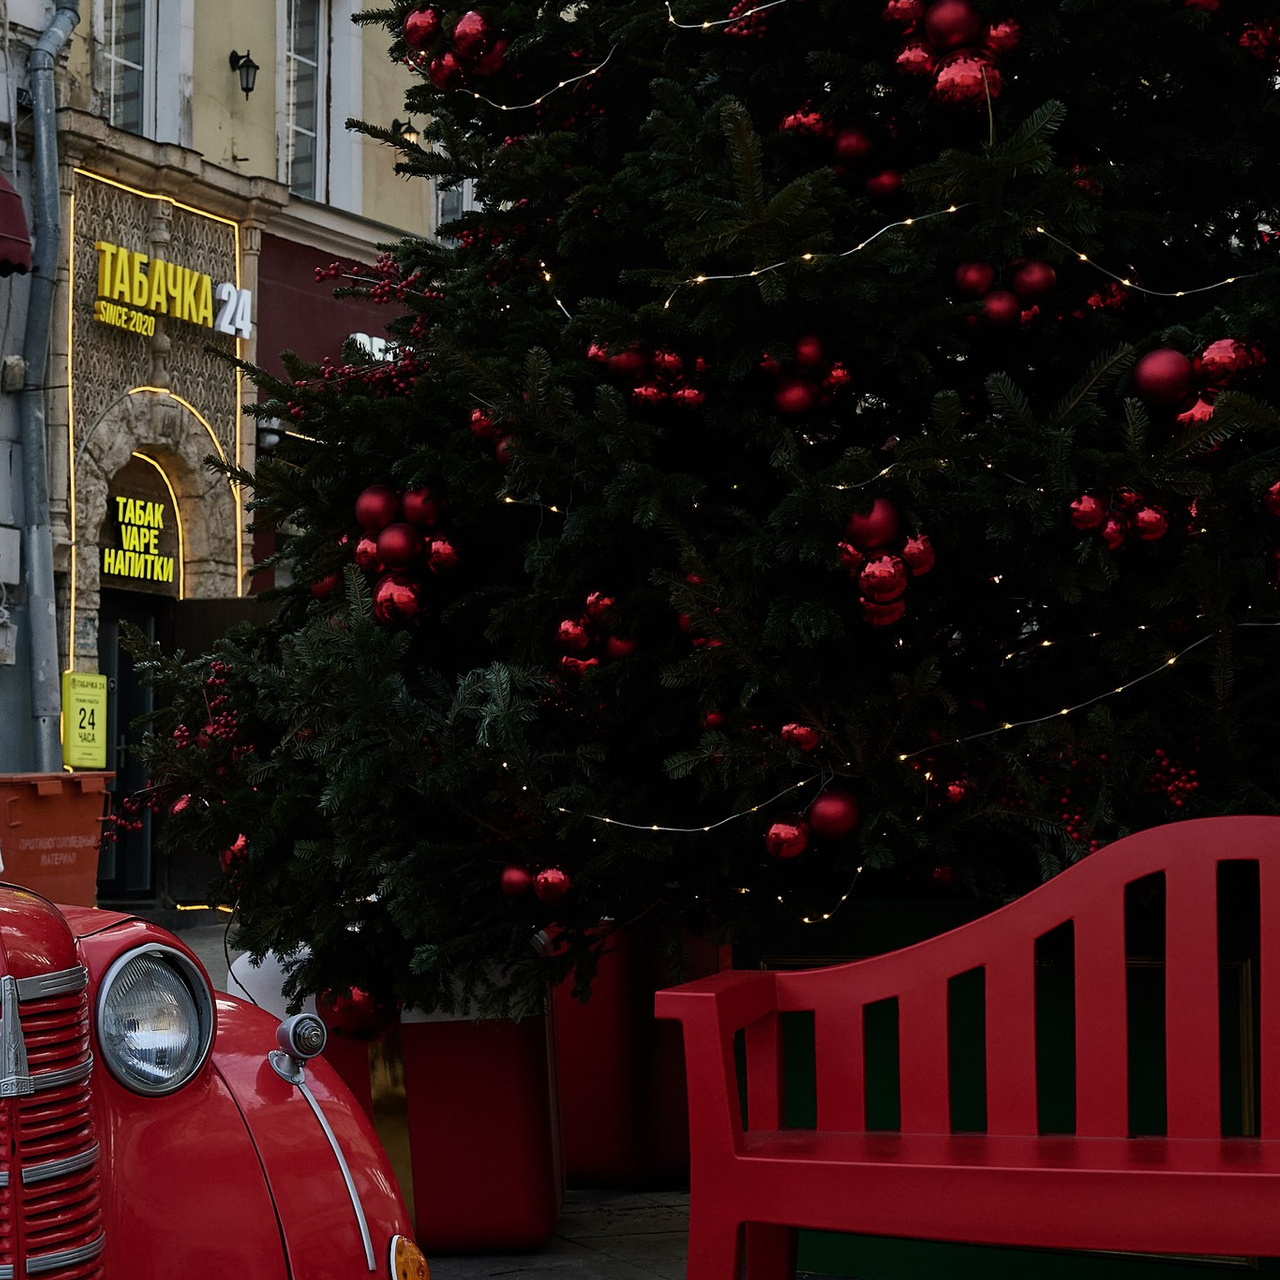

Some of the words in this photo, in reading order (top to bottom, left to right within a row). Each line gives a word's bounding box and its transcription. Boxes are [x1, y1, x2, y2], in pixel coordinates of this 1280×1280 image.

[95, 240, 214, 328] ТАБАЧКА
[214, 282, 253, 340] 24
[94, 300, 129, 329] SINCE
[129, 309, 156, 337] 2020
[115, 496, 165, 529] ТАБАК
[121, 524, 159, 554] VAPE
[103, 548, 174, 583] НАПИТКИ
[78, 707, 96, 731] 24
[78, 732, 96, 744] ЧАСА
